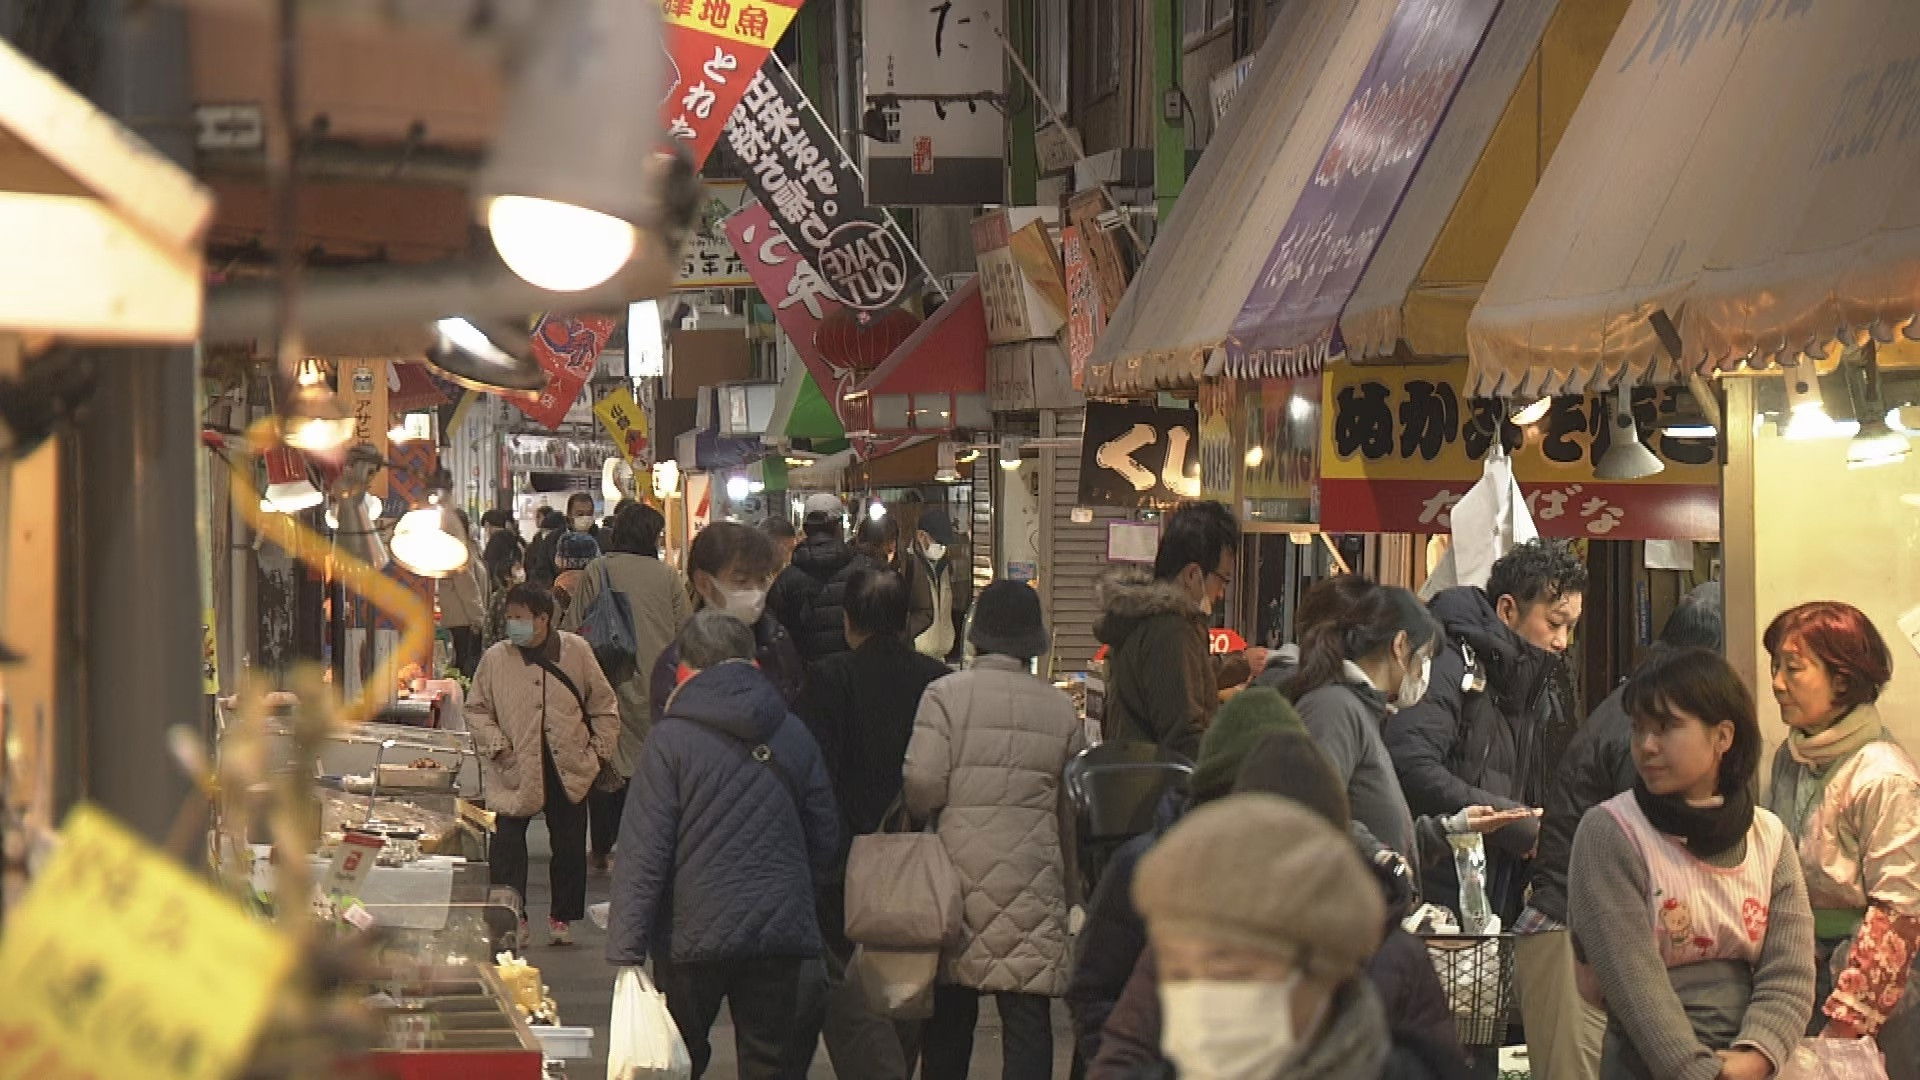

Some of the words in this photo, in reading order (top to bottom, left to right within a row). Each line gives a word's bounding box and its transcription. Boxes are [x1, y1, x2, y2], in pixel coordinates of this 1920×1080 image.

[356, 400, 372, 445] アサヒ
[1418, 484, 1624, 533] たばな
